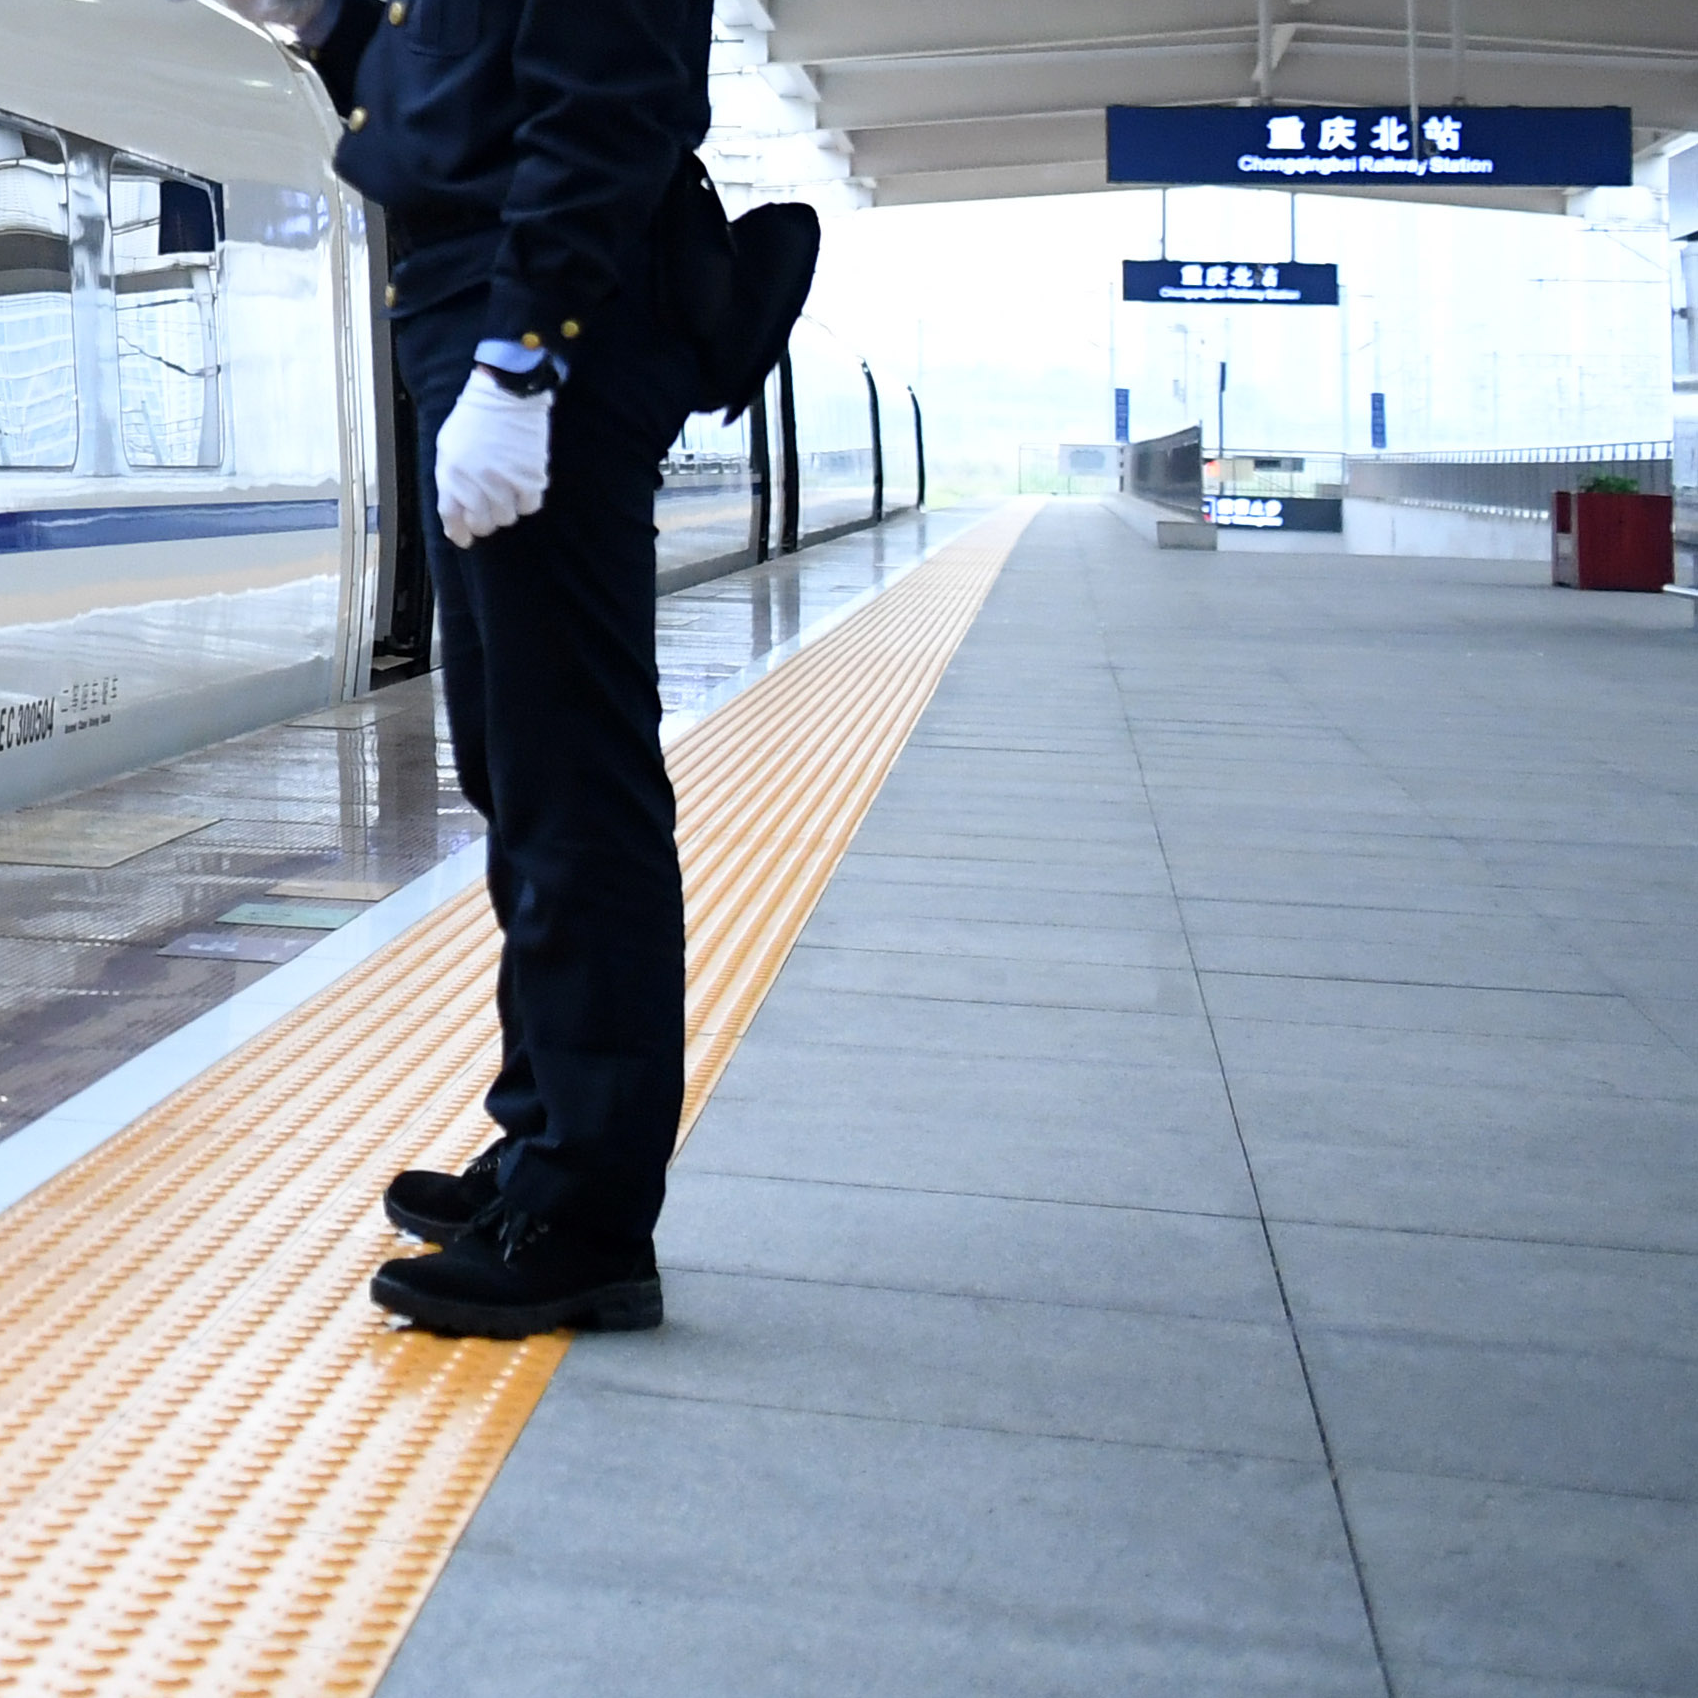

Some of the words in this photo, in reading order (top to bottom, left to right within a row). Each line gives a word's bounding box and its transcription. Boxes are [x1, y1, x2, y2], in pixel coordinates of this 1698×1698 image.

[1266, 115, 1462, 151] 重庆北站
[1358, 155, 1428, 176] Railway
[1429, 156, 1493, 173] Station
